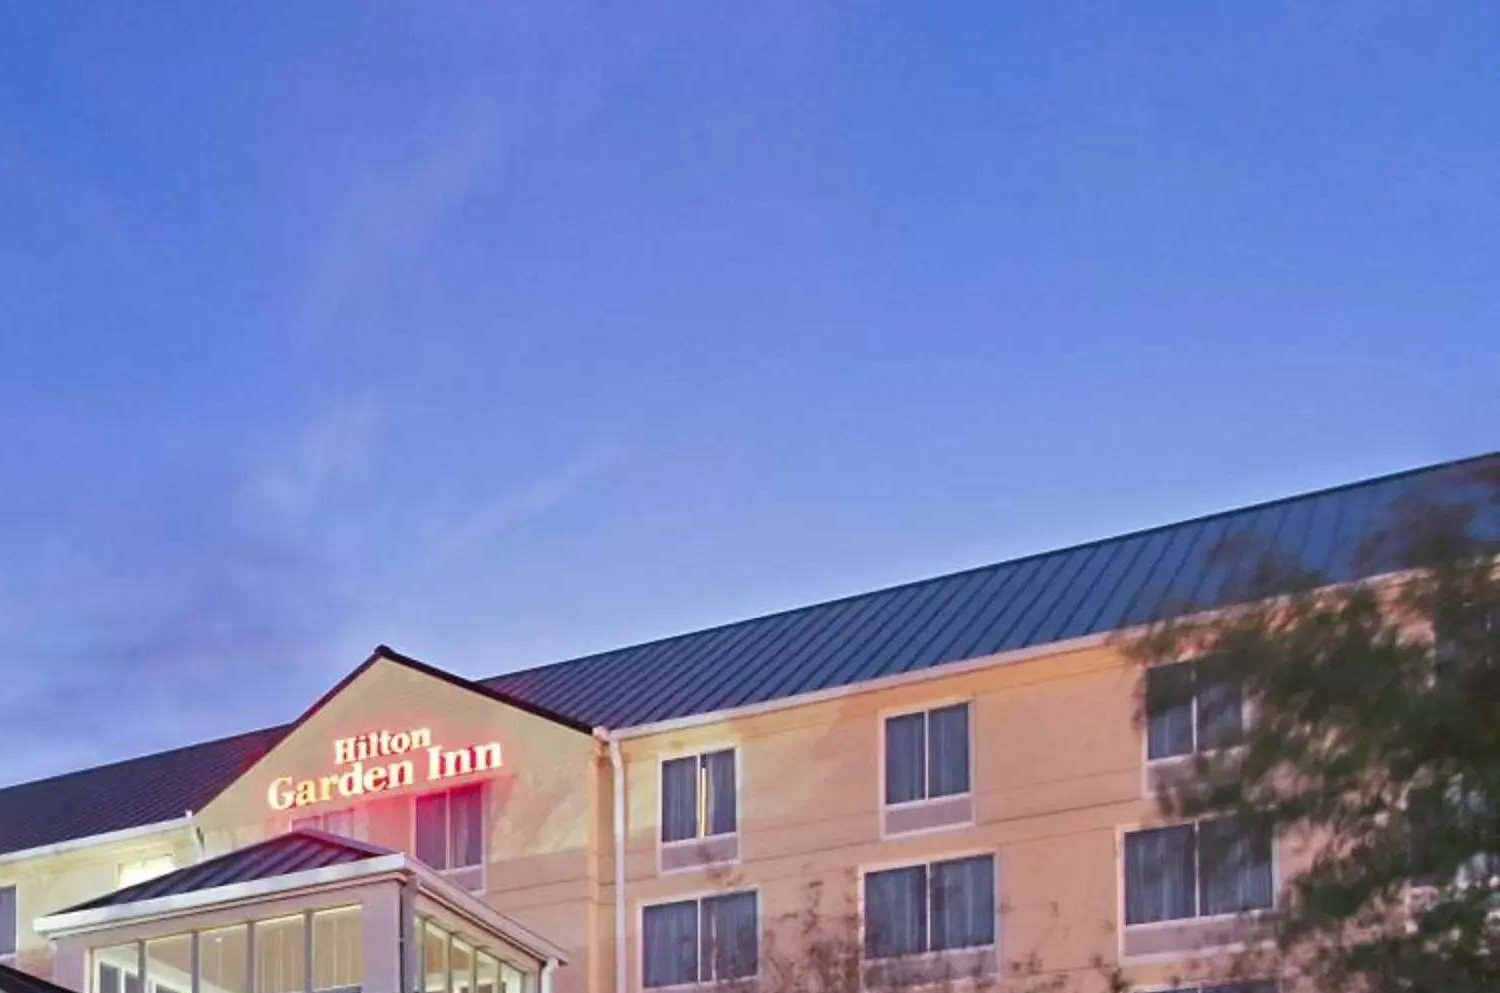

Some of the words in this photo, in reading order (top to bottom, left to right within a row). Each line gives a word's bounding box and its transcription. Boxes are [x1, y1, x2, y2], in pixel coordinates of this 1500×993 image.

[334, 727, 432, 764] Hilton
[267, 759, 414, 810] Garden
[426, 741, 502, 781] Inn
